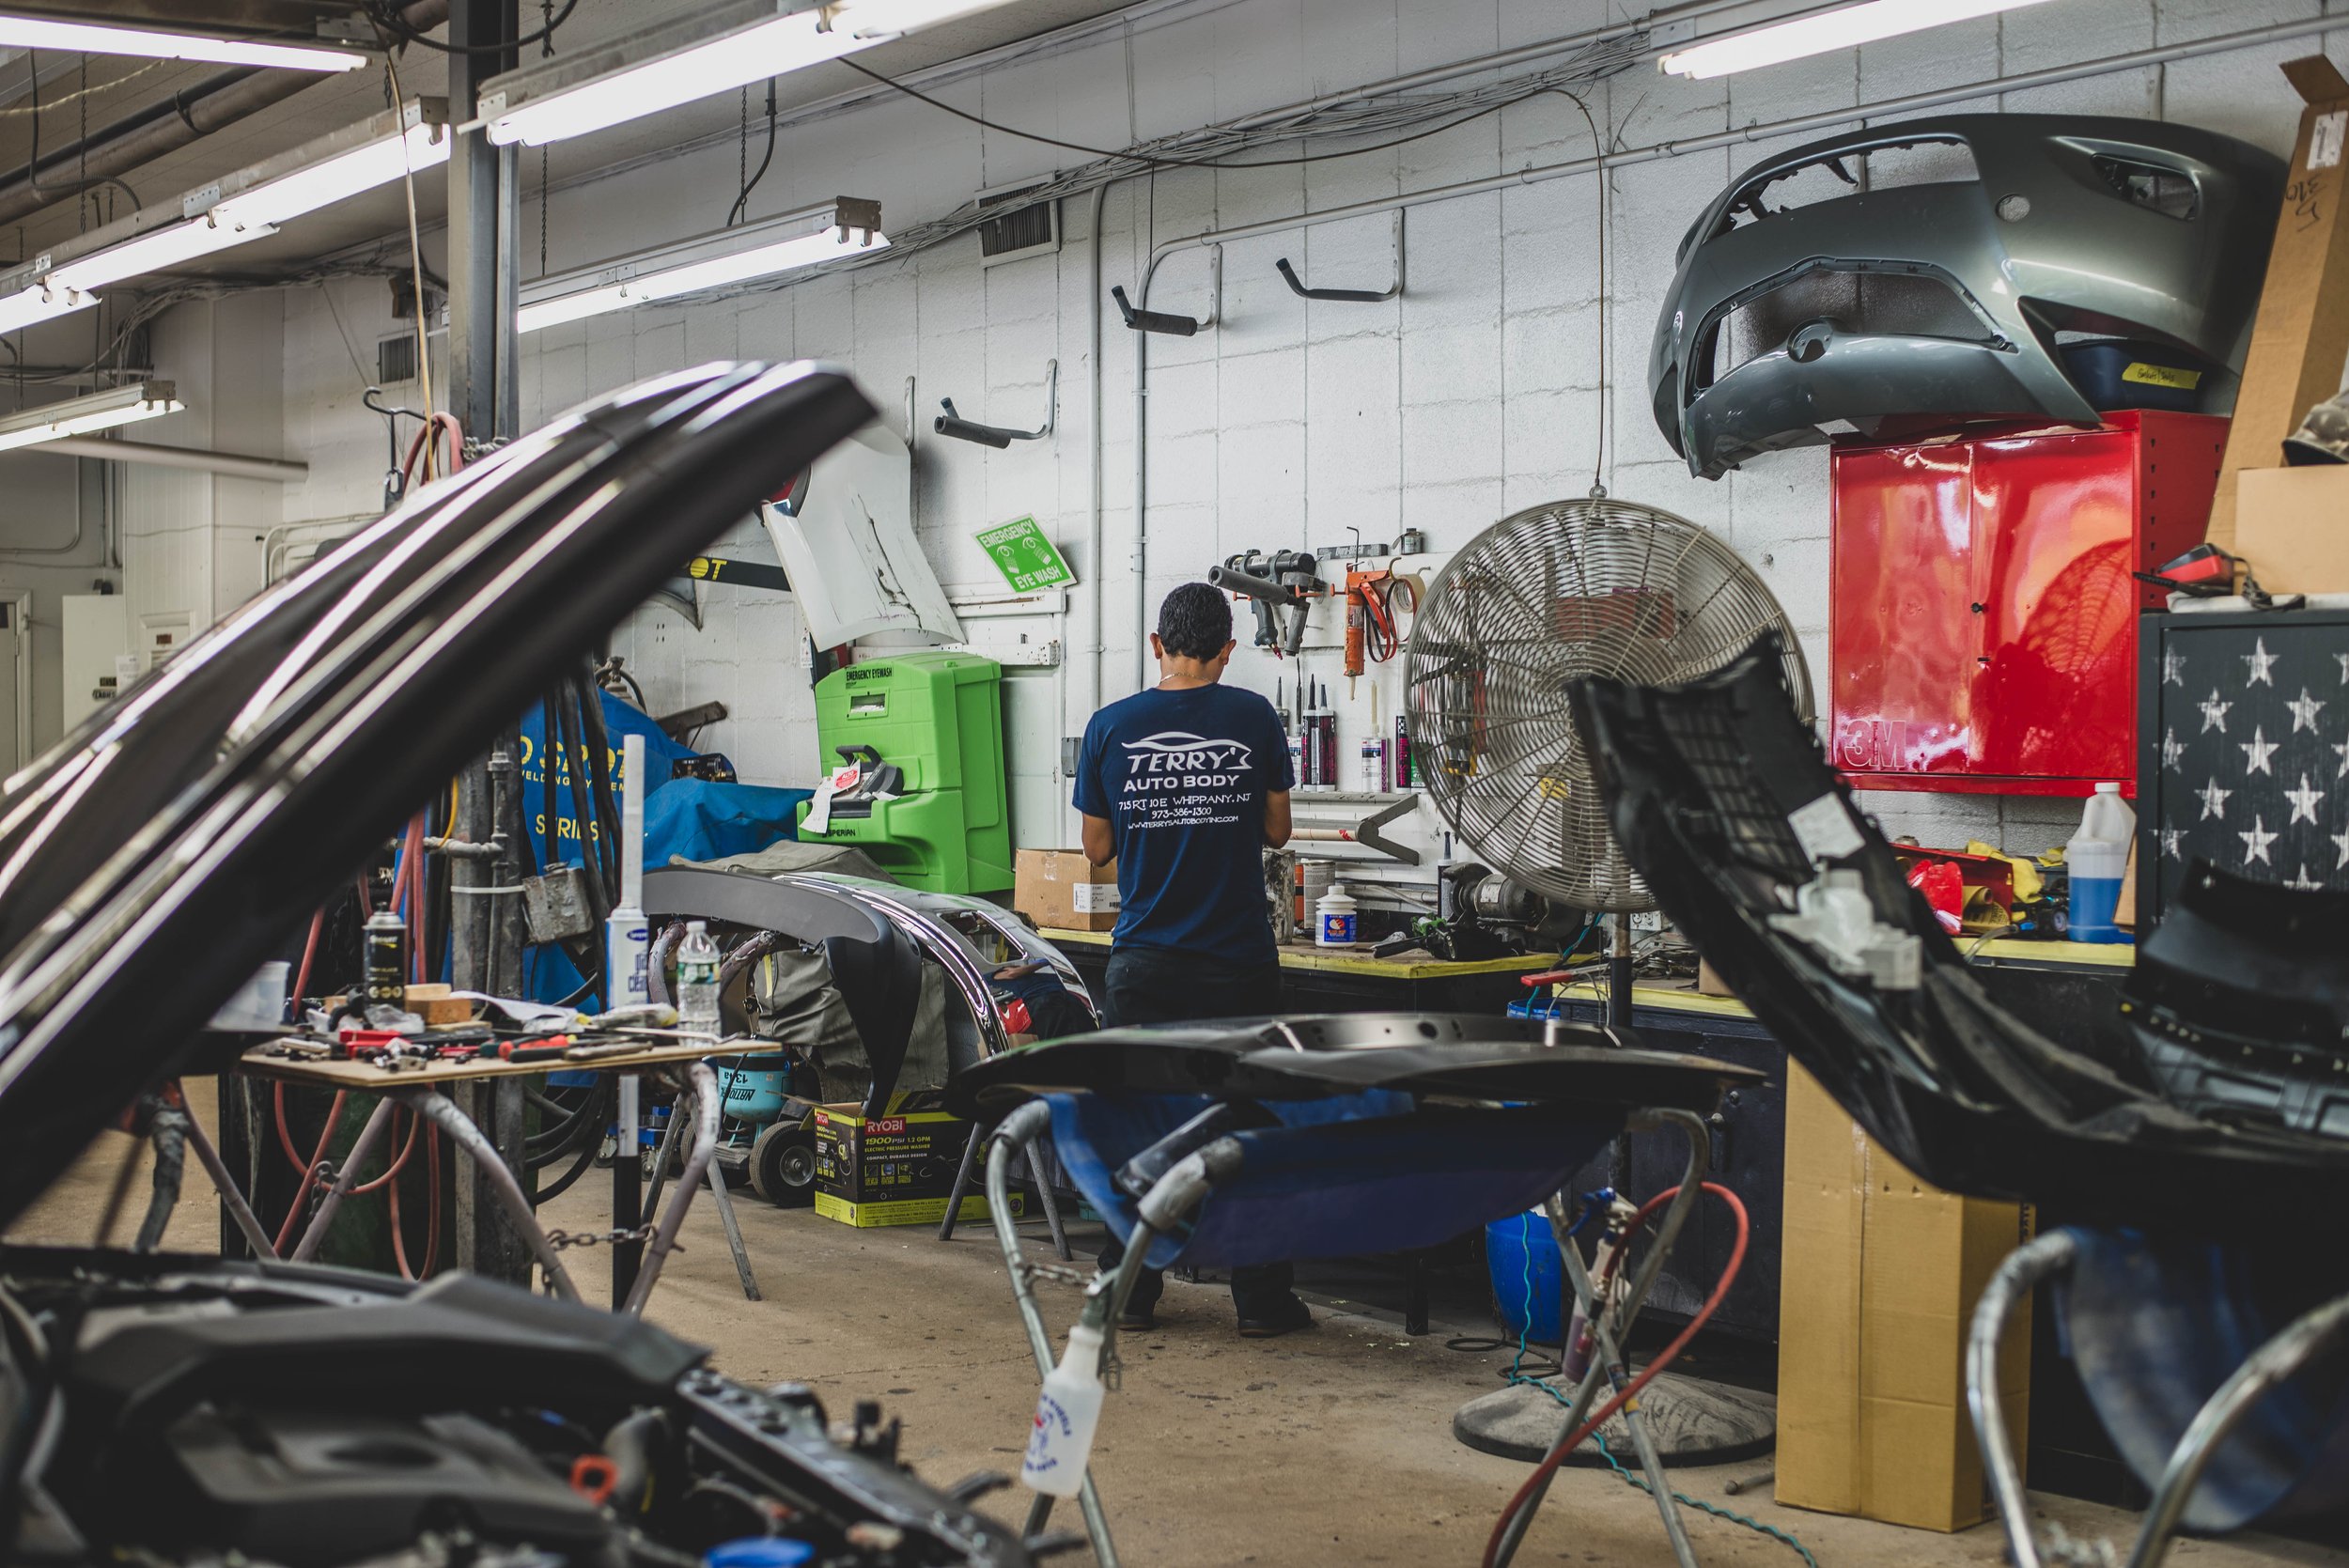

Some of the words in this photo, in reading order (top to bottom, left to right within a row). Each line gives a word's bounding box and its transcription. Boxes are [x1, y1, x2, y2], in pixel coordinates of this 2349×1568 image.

[979, 520, 1035, 549] EMERGENCY
[1014, 573, 1035, 589] EYE
[1033, 565, 1062, 583] WASH
[846, 670, 871, 681] EMERGENCY
[872, 667, 893, 678] EYEWASH
[1844, 719, 1906, 768] 3M
[1123, 777, 1178, 793] AUTO
[1183, 775, 1239, 788] BODY
[1237, 793, 1252, 802] NJ
[1151, 807, 1212, 819] 973-386-1300
[724, 1071, 748, 1084] 13a
[866, 1119, 903, 1133] RYOBI
[864, 1137, 892, 1145] 1900
